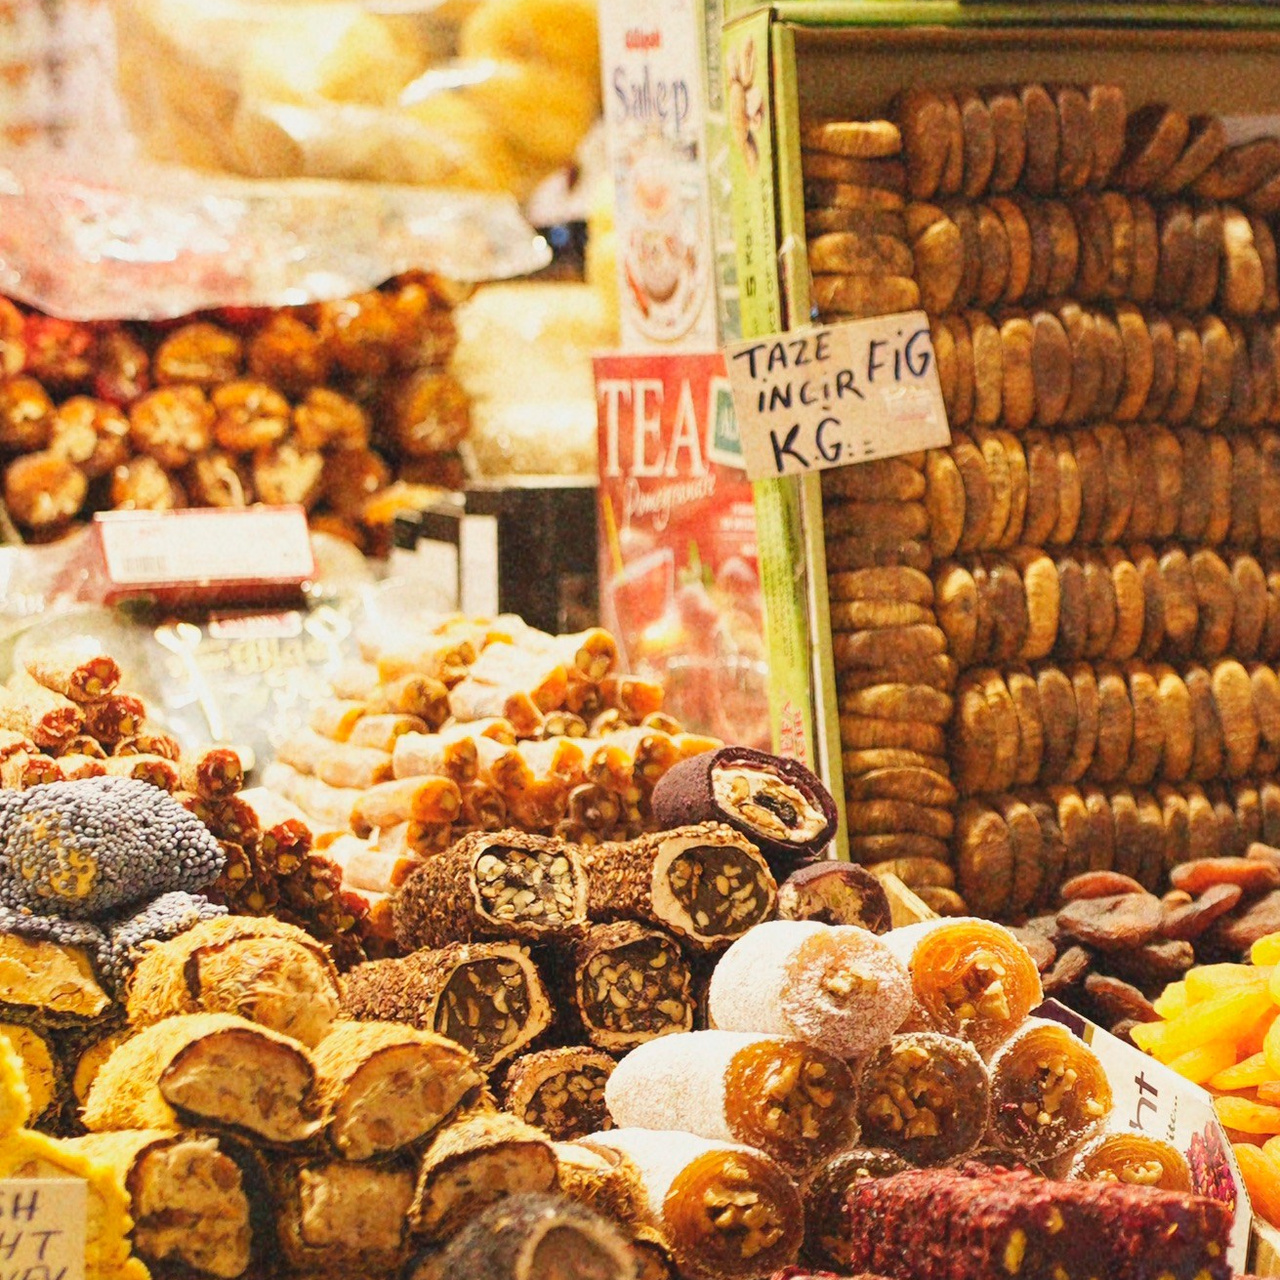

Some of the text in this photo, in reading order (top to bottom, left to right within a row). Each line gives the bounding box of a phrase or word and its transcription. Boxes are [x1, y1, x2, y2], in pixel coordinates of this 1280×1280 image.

[611, 63, 691, 134] Salep
[732, 331, 833, 380] TAZE
[597, 377, 711, 479] TEA
